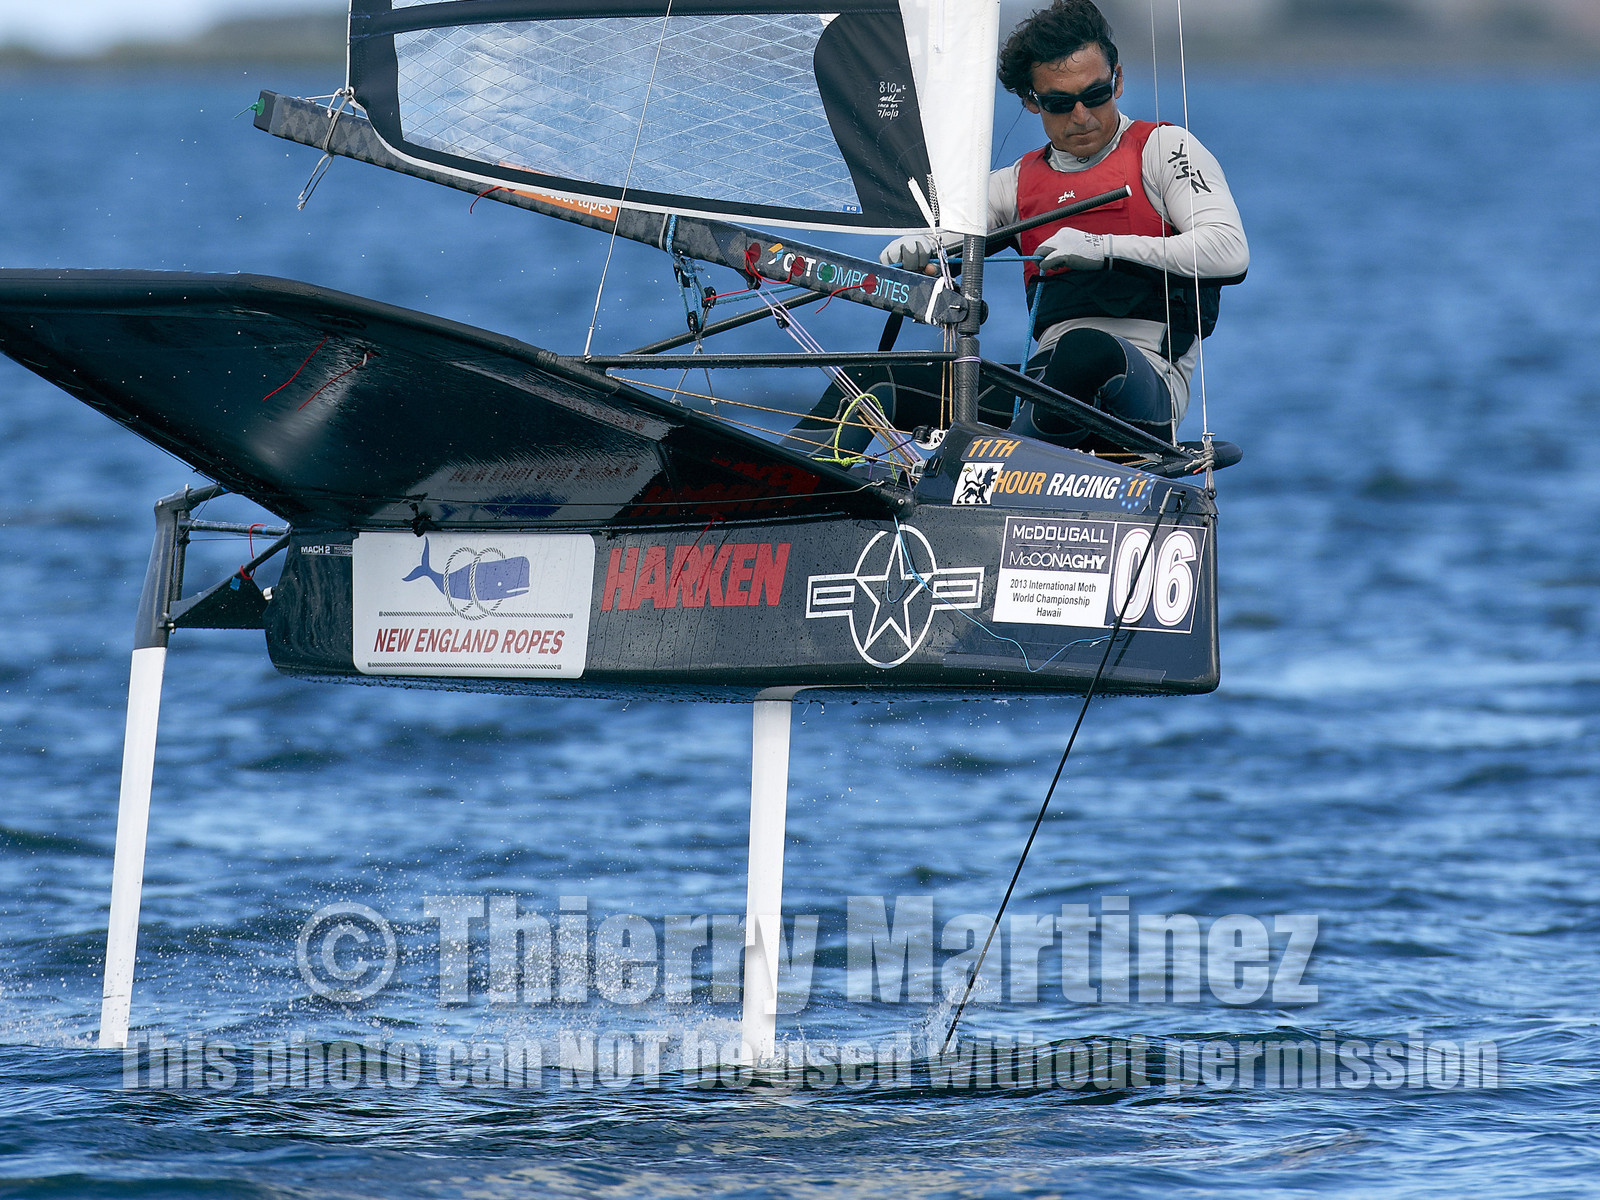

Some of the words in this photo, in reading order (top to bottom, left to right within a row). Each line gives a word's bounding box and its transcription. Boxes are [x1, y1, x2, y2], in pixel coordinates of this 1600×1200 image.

[1057, 189, 1076, 204] zhik
[783, 254, 816, 277] CT
[968, 438, 1021, 458] 11TH
[993, 470, 1047, 495] HOUR
[1046, 472, 1121, 500] RACING
[300, 545, 324, 554] MACH
[325, 545, 330, 554] 2
[601, 542, 791, 612] HARKEN
[1010, 578, 1028, 589] 2013
[1029, 579, 1076, 592] International
[1077, 583, 1097, 593] Moth
[1112, 527, 1197, 627] 06
[1012, 592, 1034, 604] World
[1036, 594, 1090, 607] Championship
[1036, 607, 1062, 618] Hawaii
[374, 628, 414, 652] NEW
[414, 628, 499, 653] ENGLAND
[501, 629, 565, 654] ROPES
